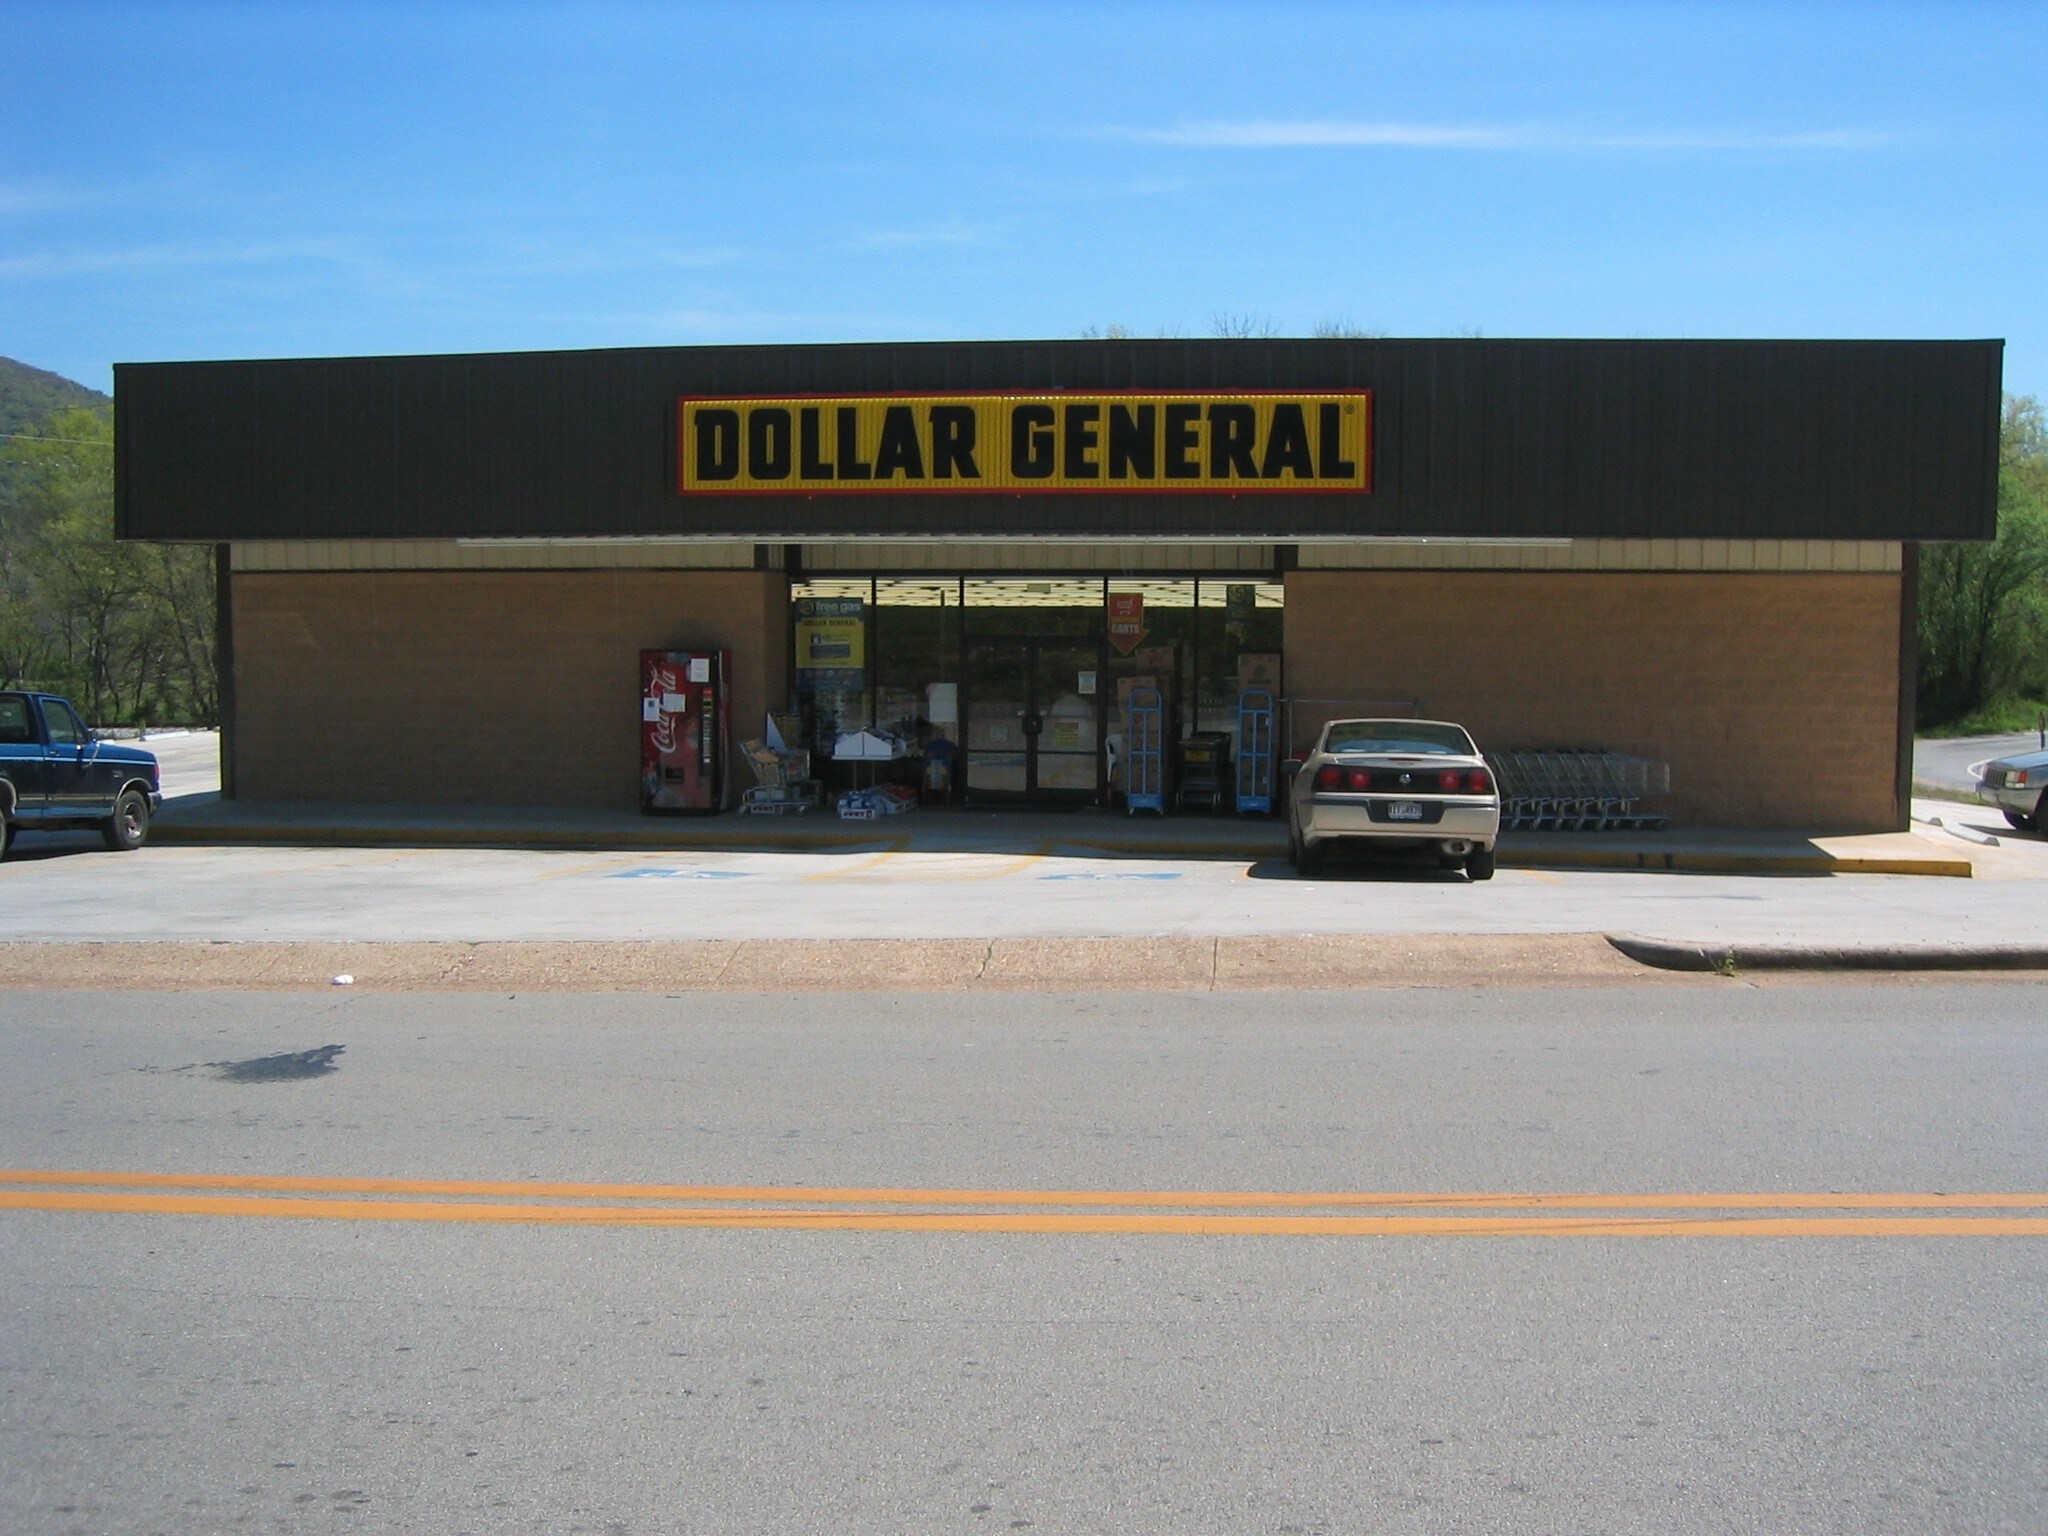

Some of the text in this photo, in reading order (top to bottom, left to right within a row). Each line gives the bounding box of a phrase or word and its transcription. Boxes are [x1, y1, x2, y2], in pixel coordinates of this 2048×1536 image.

[695, 403, 1355, 481] DOLLAR GENERAL
[815, 601, 838, 612] free
[840, 602, 861, 614] gas
